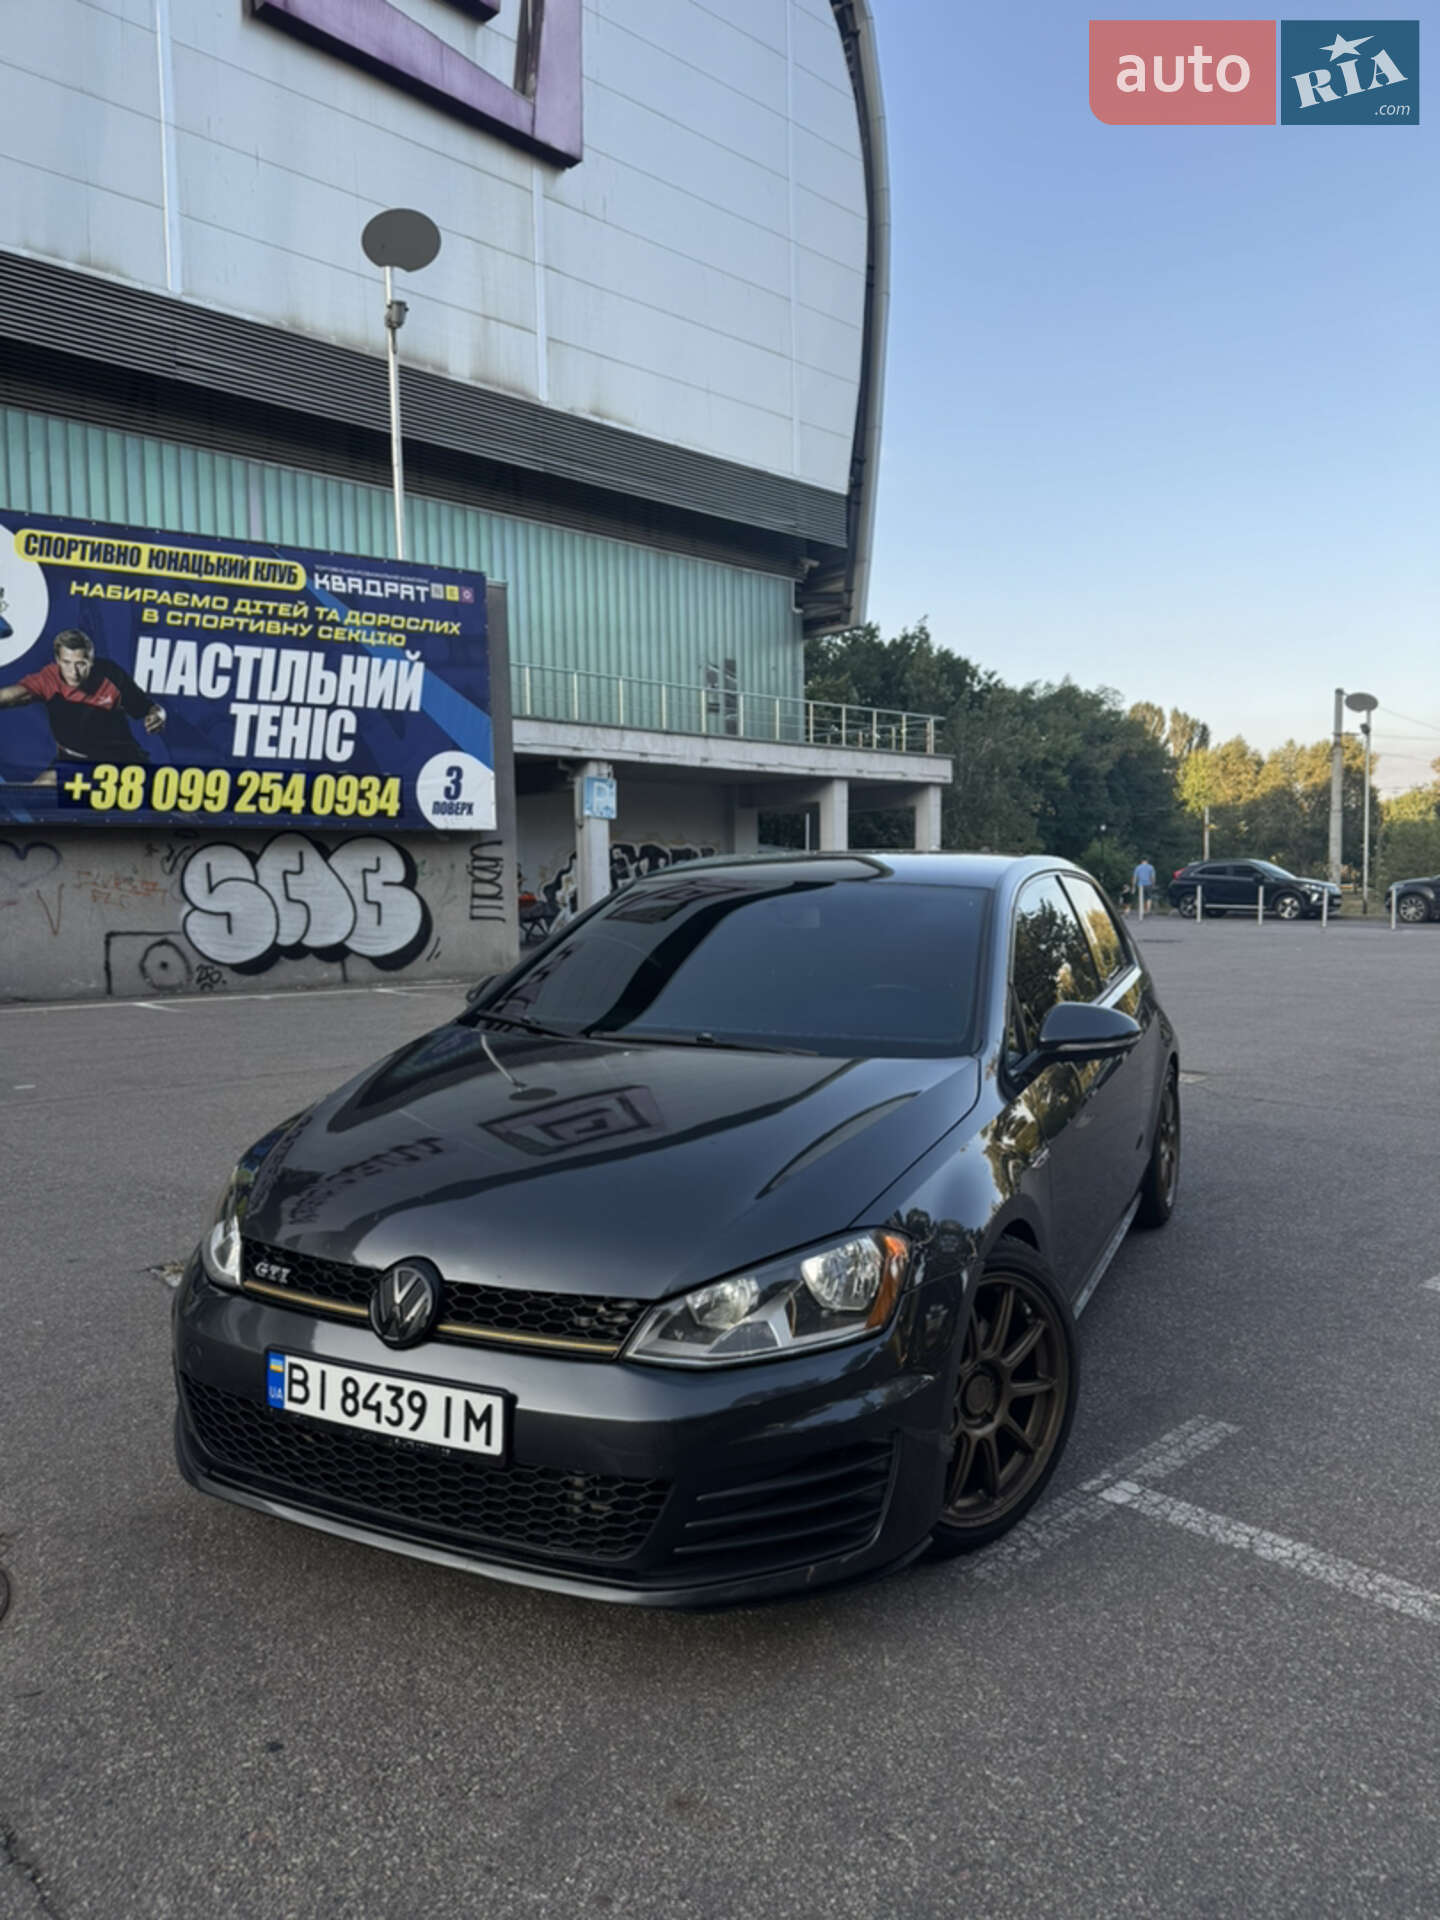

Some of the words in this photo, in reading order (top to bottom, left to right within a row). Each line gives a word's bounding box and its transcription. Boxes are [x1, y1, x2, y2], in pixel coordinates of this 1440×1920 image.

[23, 532, 142, 568] СПОРТИВНО
[147, 547, 251, 581] ЮНАЦЬКИЙ
[253, 559, 299, 586] КЛУБ
[69, 580, 229, 611] НАБИРАЄМО
[233, 598, 310, 620] ДІТЕЙ
[315, 606, 341, 622] ТА
[344, 609, 462, 636] ДОРОСЛИХ
[313, 572, 430, 603] КВАДРАТ
[141, 607, 160, 624] В
[166, 610, 314, 638] СПОРТИВНУ
[317, 624, 407, 648] СЕКЦІЮ
[133, 636, 426, 712] НАСТІЛЬНИЙ
[229, 701, 358, 763] ТЕНІС
[63, 764, 147, 811] +38
[151, 766, 231, 813] 099
[234, 770, 307, 815] 254
[310, 773, 402, 817] 0934
[443, 765, 464, 801] 3
[432, 800, 474, 816] ПОВЕРХ
[254, 1261, 291, 1285] GTI
[268, 1386, 284, 1399] UA
[287, 1363, 327, 1411] BI
[340, 1376, 428, 1432] 8439
[443, 1395, 493, 1447] IM
